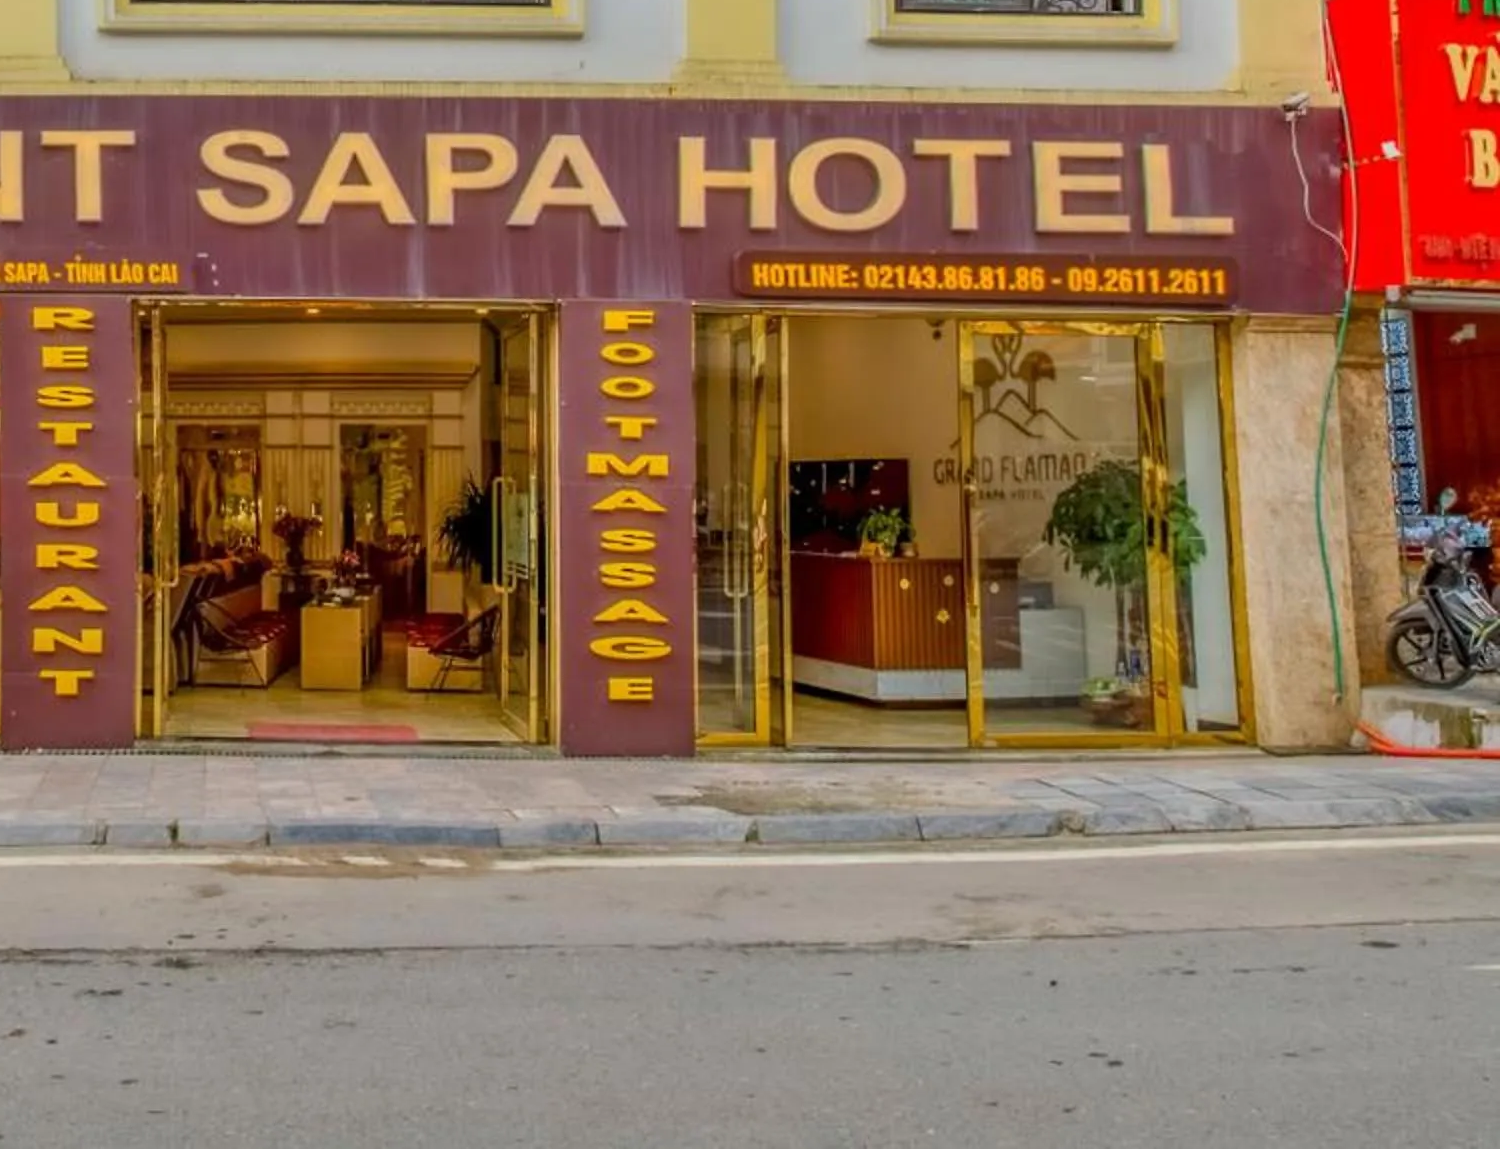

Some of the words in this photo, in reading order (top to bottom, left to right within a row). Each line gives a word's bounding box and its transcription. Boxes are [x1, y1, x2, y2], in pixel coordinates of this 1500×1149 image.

[196, 129, 628, 228] SAPA
[677, 135, 1236, 236] HOTEL
[4, 261, 50, 284] SAPA
[146, 262, 179, 285] CAI
[752, 261, 859, 289] HOTLINE:
[863, 264, 1045, 292] 02143.86.81.86
[1067, 267, 1227, 295] 09.2611.2611
[600, 310, 657, 439] FOOT
[26, 306, 107, 697] RESTAURANT
[934, 457, 993, 484] GRND
[1001, 453, 1086, 483] FLAMAN
[586, 452, 672, 701] MASSAGE
